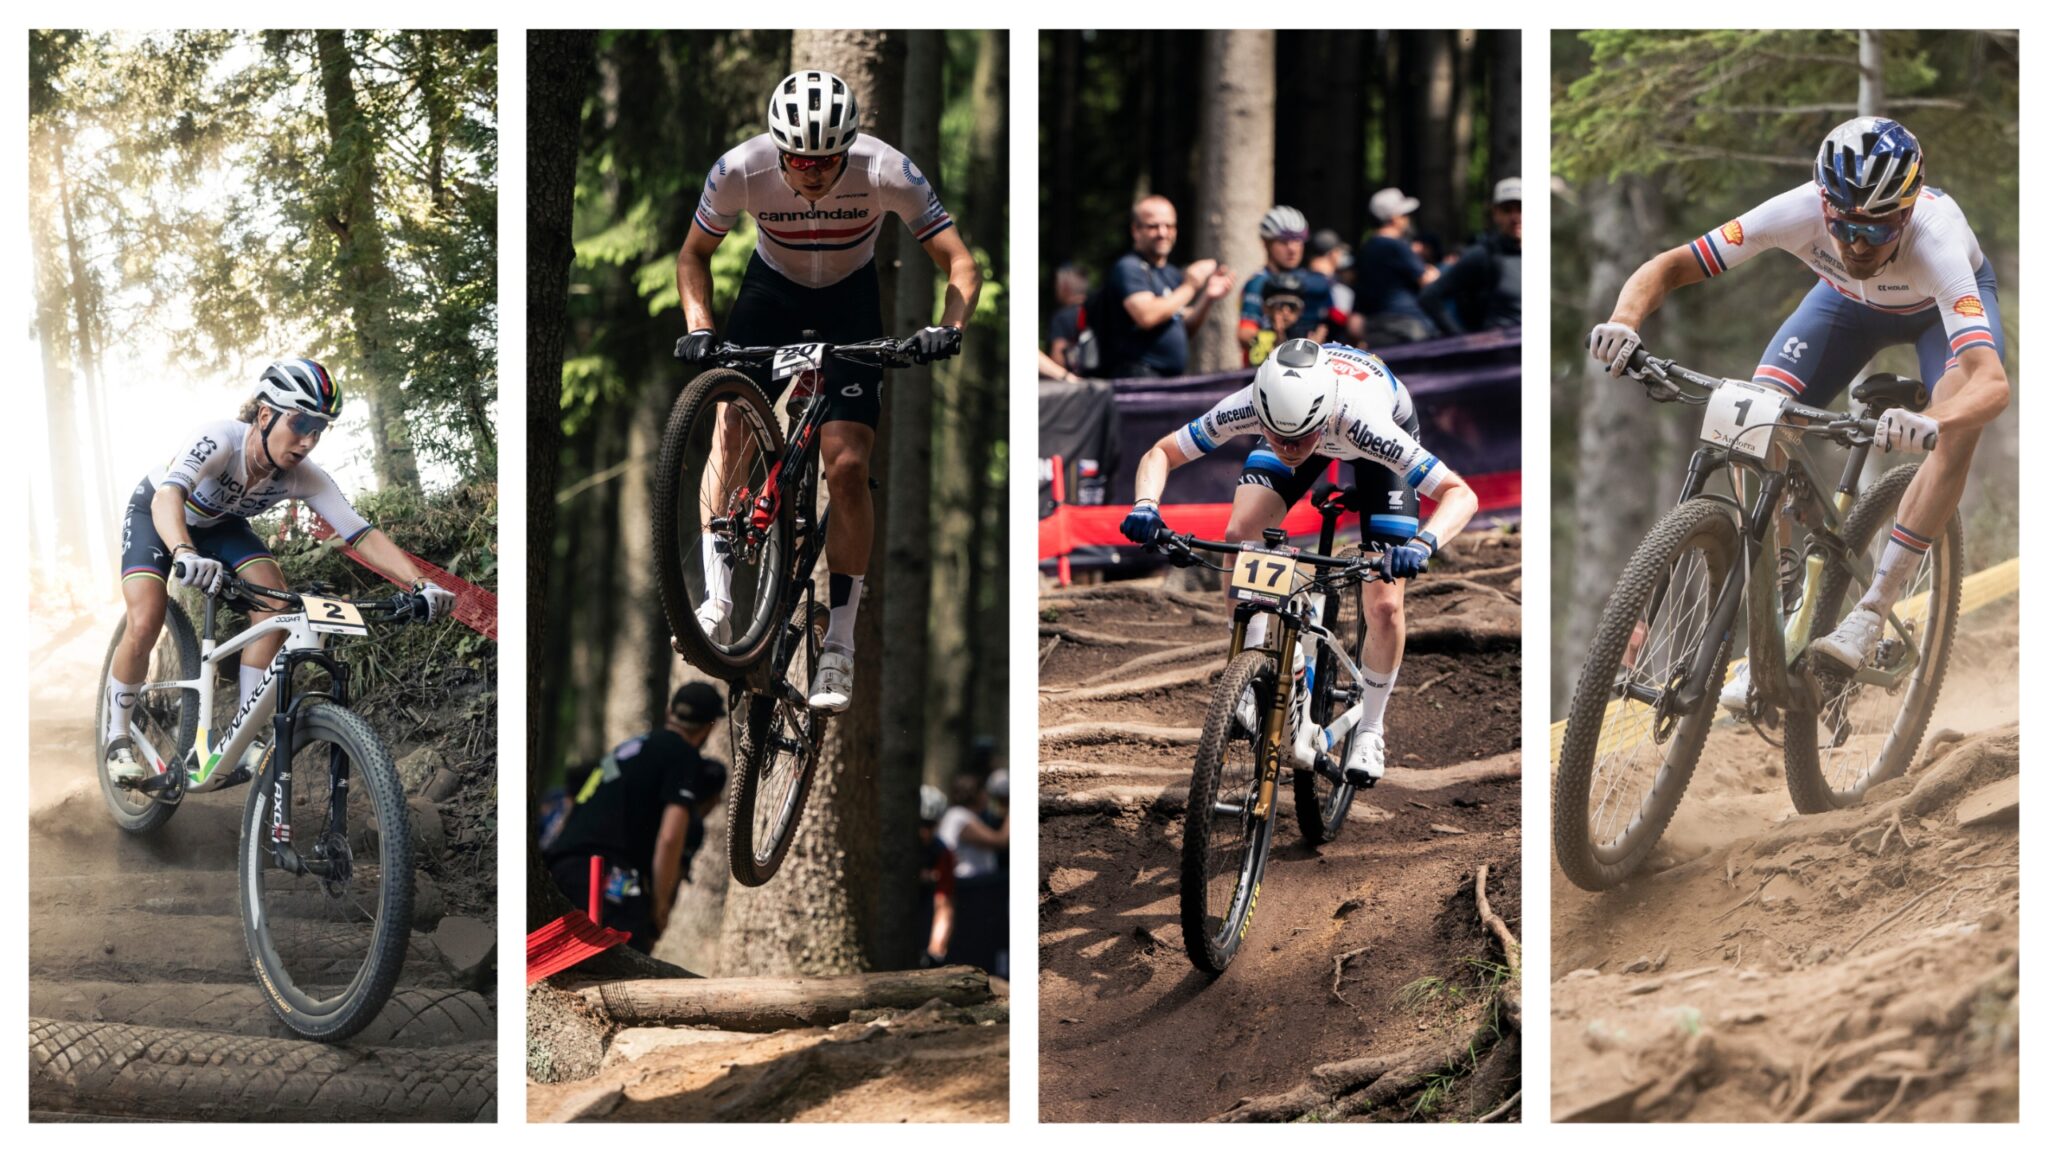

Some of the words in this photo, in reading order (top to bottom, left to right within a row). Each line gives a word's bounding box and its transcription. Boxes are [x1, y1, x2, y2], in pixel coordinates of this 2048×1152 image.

[758, 207, 868, 222] cannondale
[1682, 372, 1711, 386] MOST
[1734, 398, 1754, 427] 1
[1793, 407, 1825, 419] MOST
[1347, 419, 1404, 460] Alpecin
[184, 436, 217, 472] INEOS
[211, 487, 268, 515] INEOS
[1245, 559, 1287, 587] 17
[323, 602, 346, 620] 2
